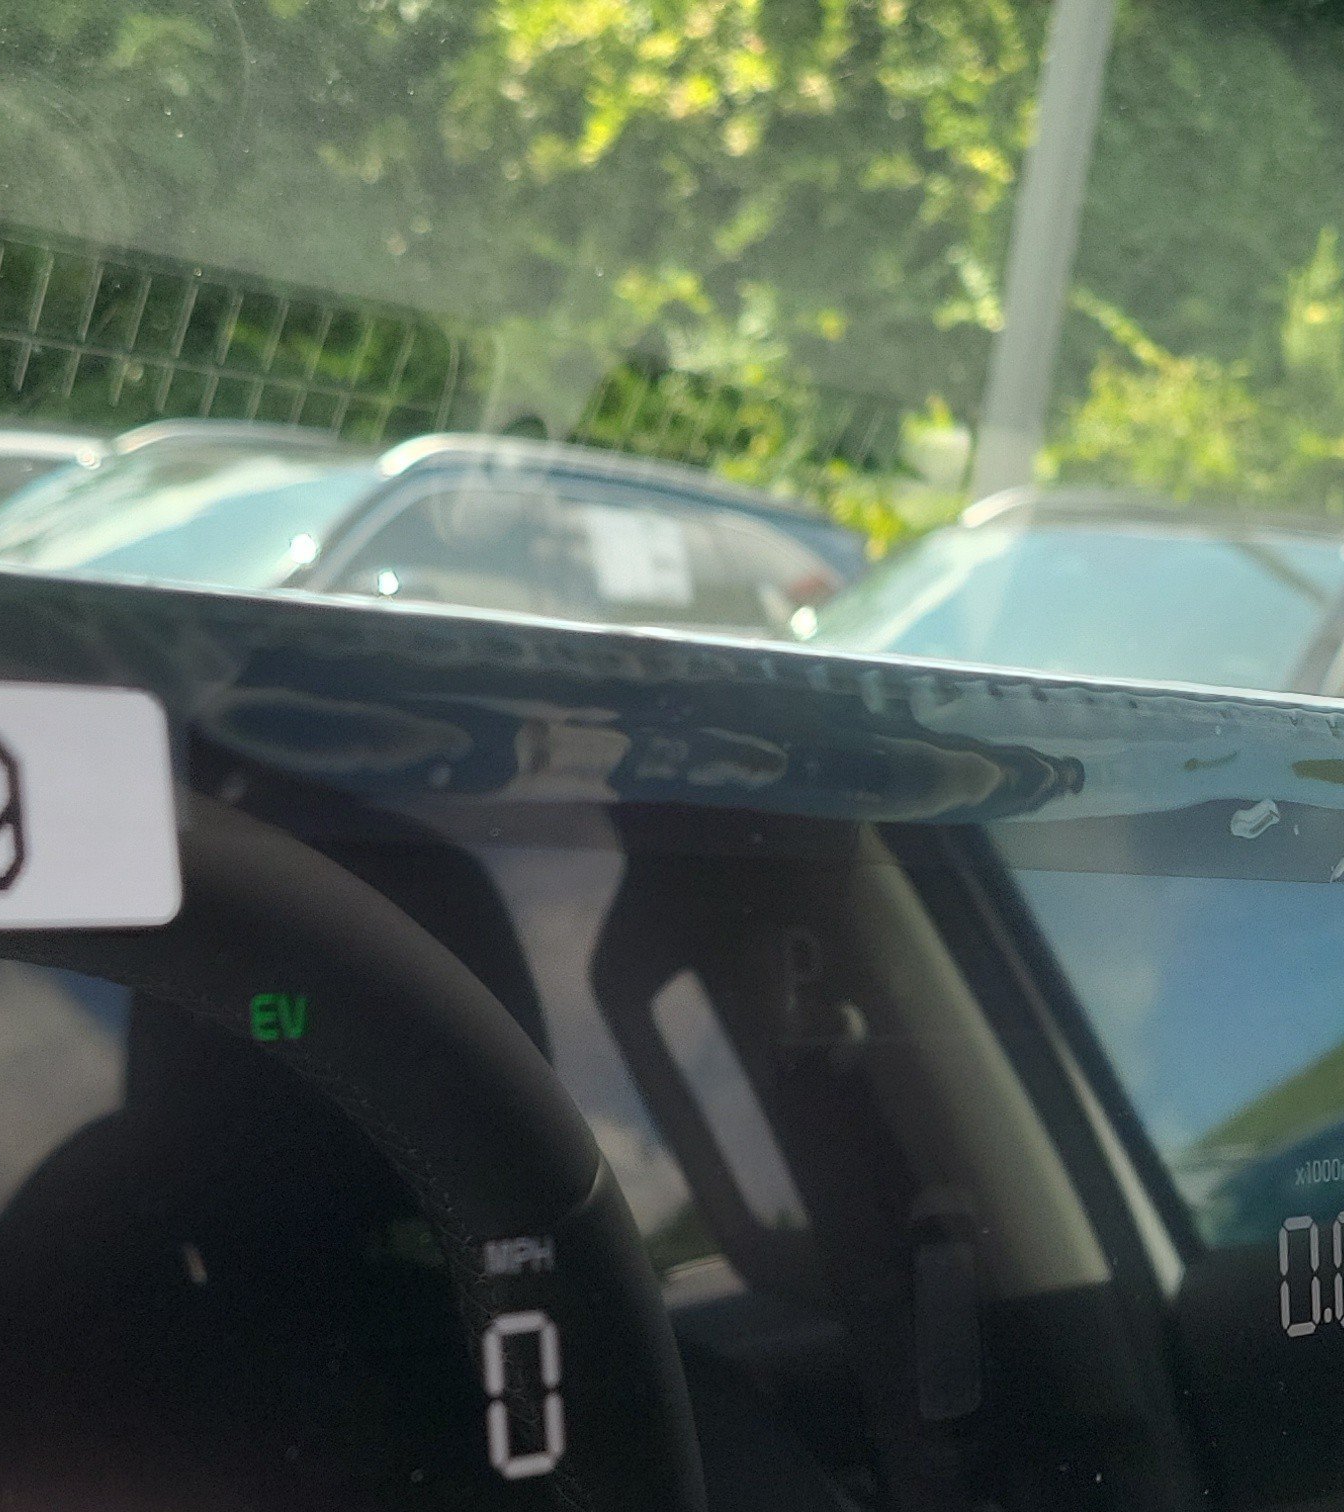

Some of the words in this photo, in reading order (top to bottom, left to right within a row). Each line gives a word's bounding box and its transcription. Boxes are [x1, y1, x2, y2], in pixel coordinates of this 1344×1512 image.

[251, 994, 308, 1041] EV
[484, 1236, 555, 1275] MPH
[482, 1309, 566, 1480] 0
